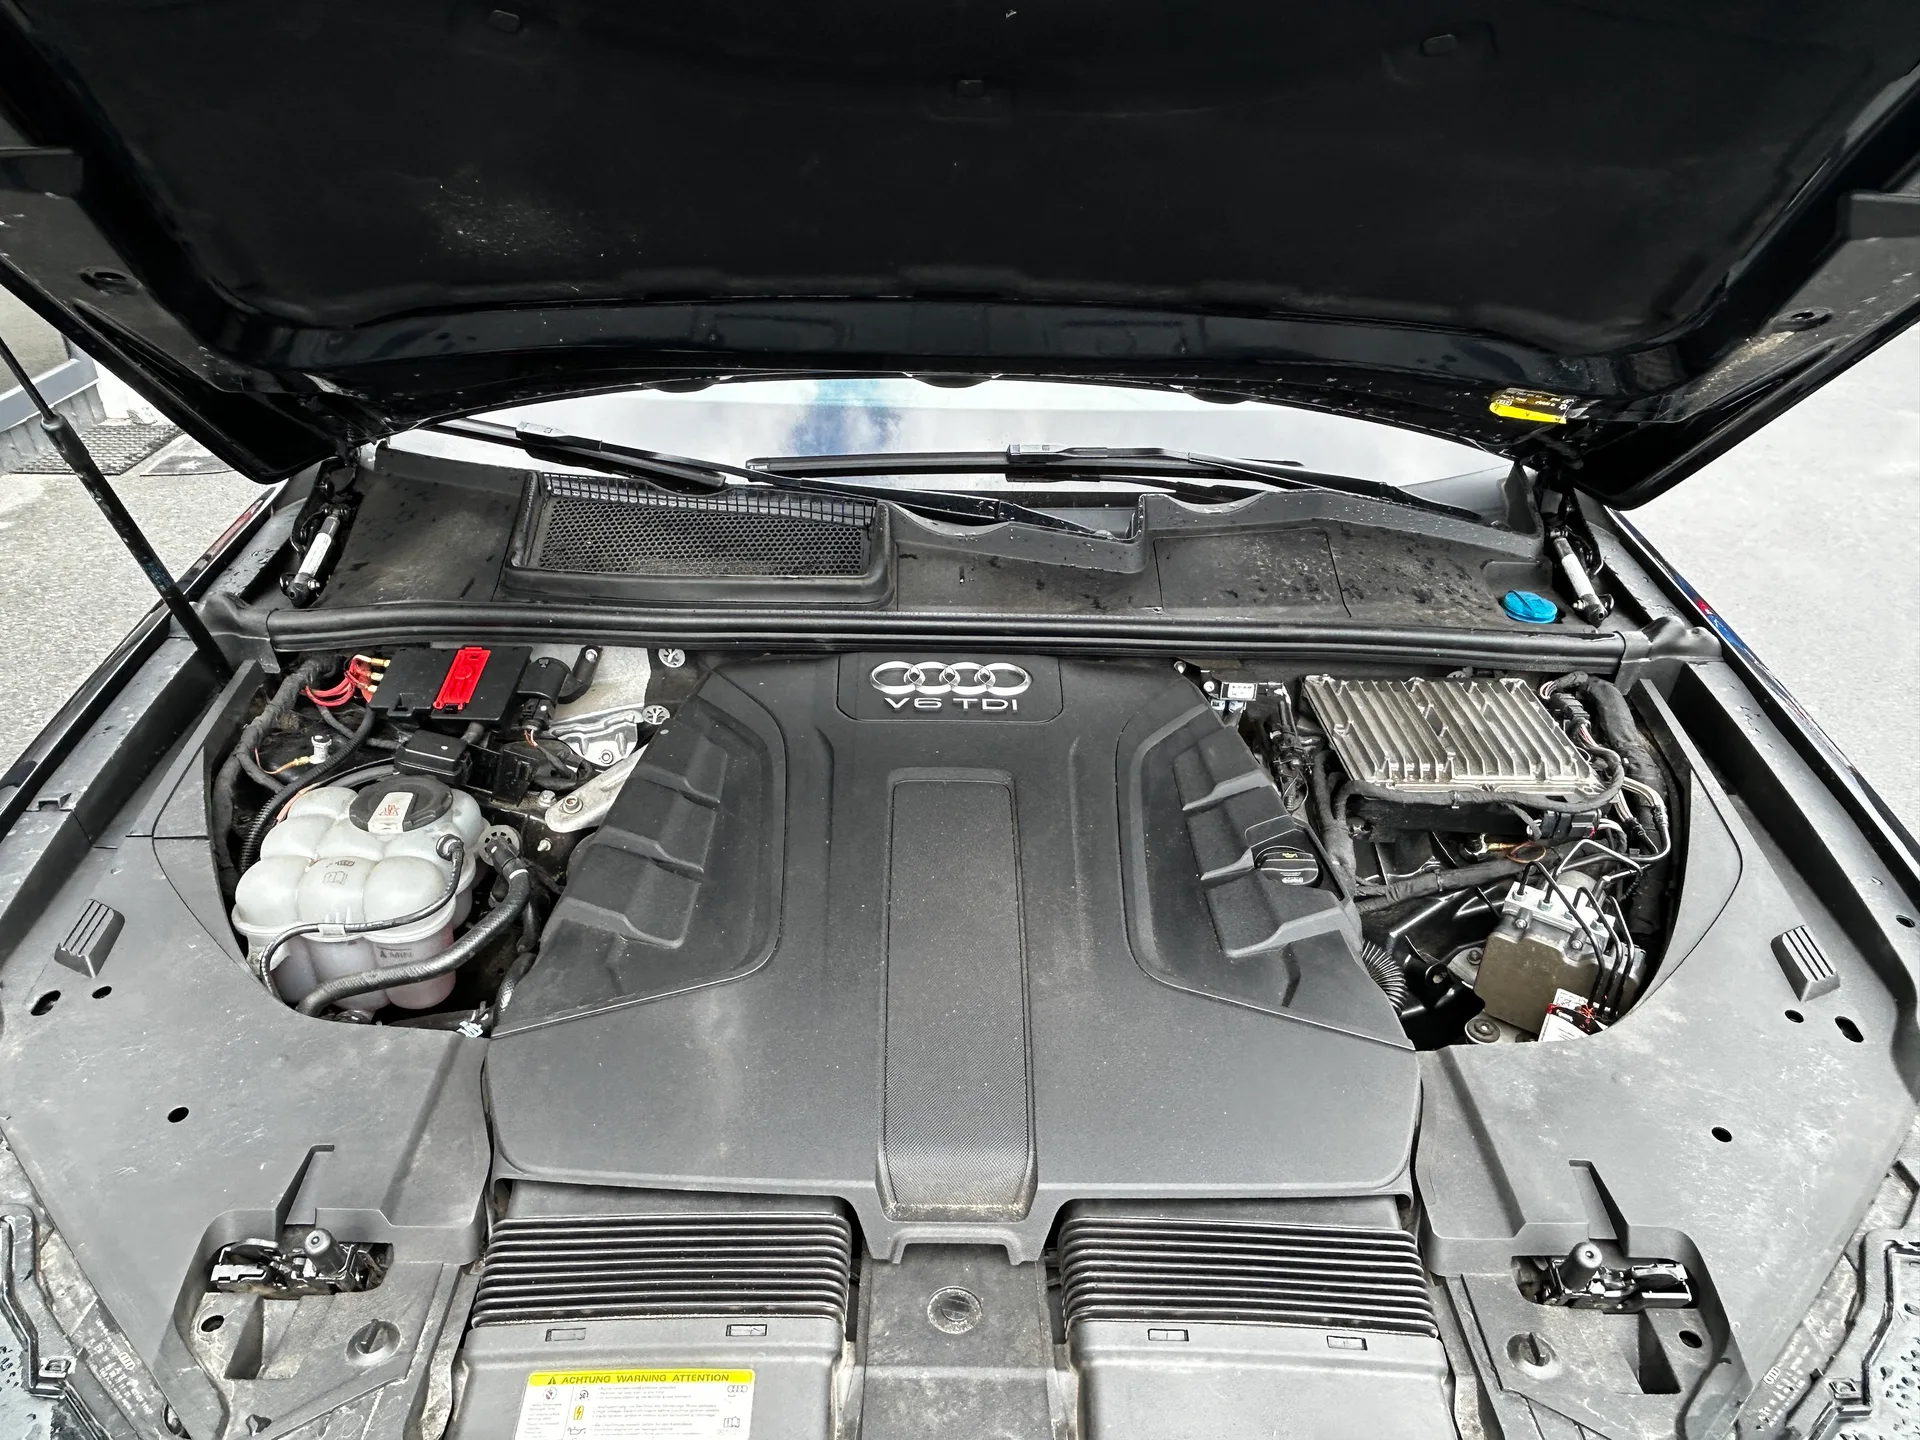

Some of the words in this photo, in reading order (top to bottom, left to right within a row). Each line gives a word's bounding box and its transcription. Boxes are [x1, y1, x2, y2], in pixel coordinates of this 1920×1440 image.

[884, 697, 943, 710] V6
[952, 698, 1018, 711] TDI
[561, 1375, 611, 1384] ACHTUNG
[616, 1374, 667, 1383] WARNING
[672, 1373, 729, 1382] ATTENTION
